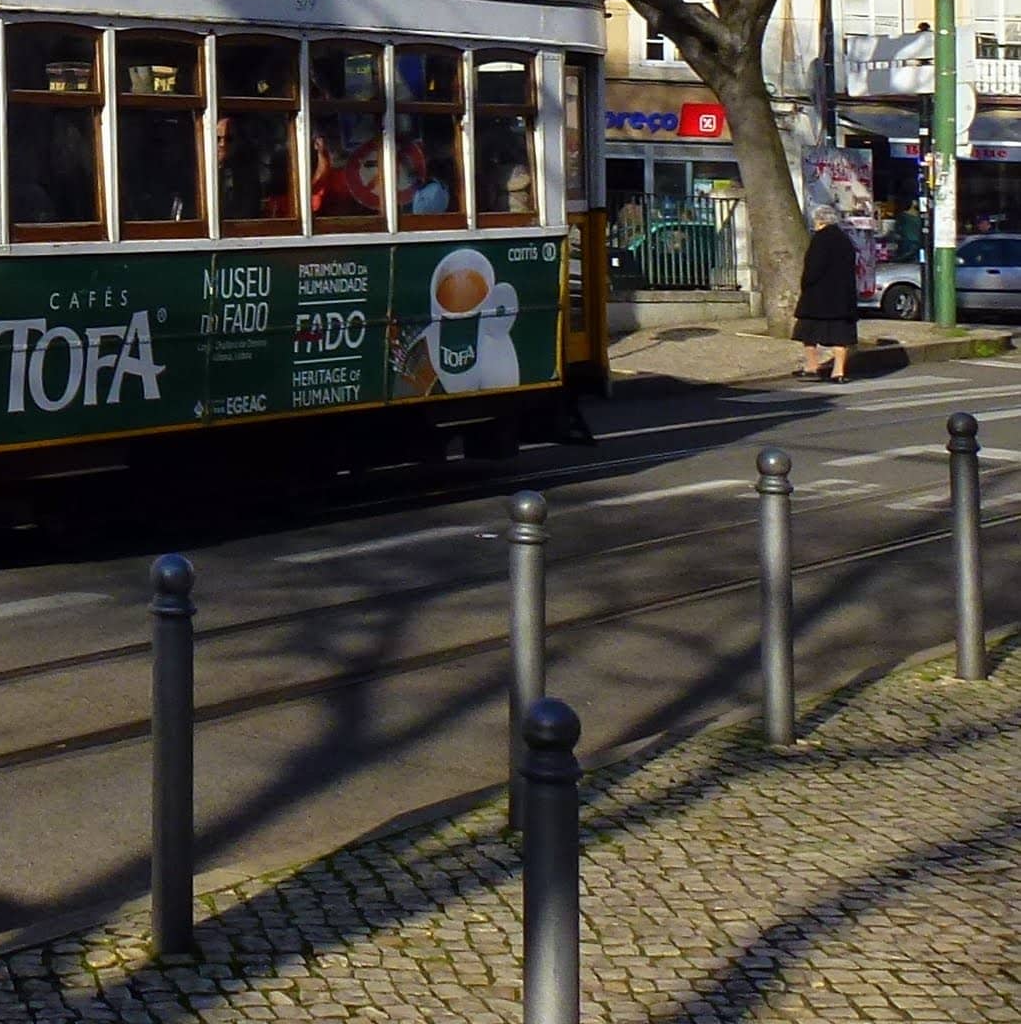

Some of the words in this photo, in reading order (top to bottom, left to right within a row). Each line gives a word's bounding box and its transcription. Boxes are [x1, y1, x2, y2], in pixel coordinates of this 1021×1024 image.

[298, 260, 356, 278] PATRIMÓNIO
[203, 266, 270, 300] MUSEU
[298, 277, 368, 295] HUMANIDADE
[49, 287, 128, 310] CAFÉS
[222, 301, 268, 334] FADO
[294, 310, 366, 353] FADO
[440, 345, 475, 369] TOFA
[292, 367, 347, 387] HERITAGE
[226, 394, 266, 415] EGEAC
[292, 384, 360, 408] HUMANITY
